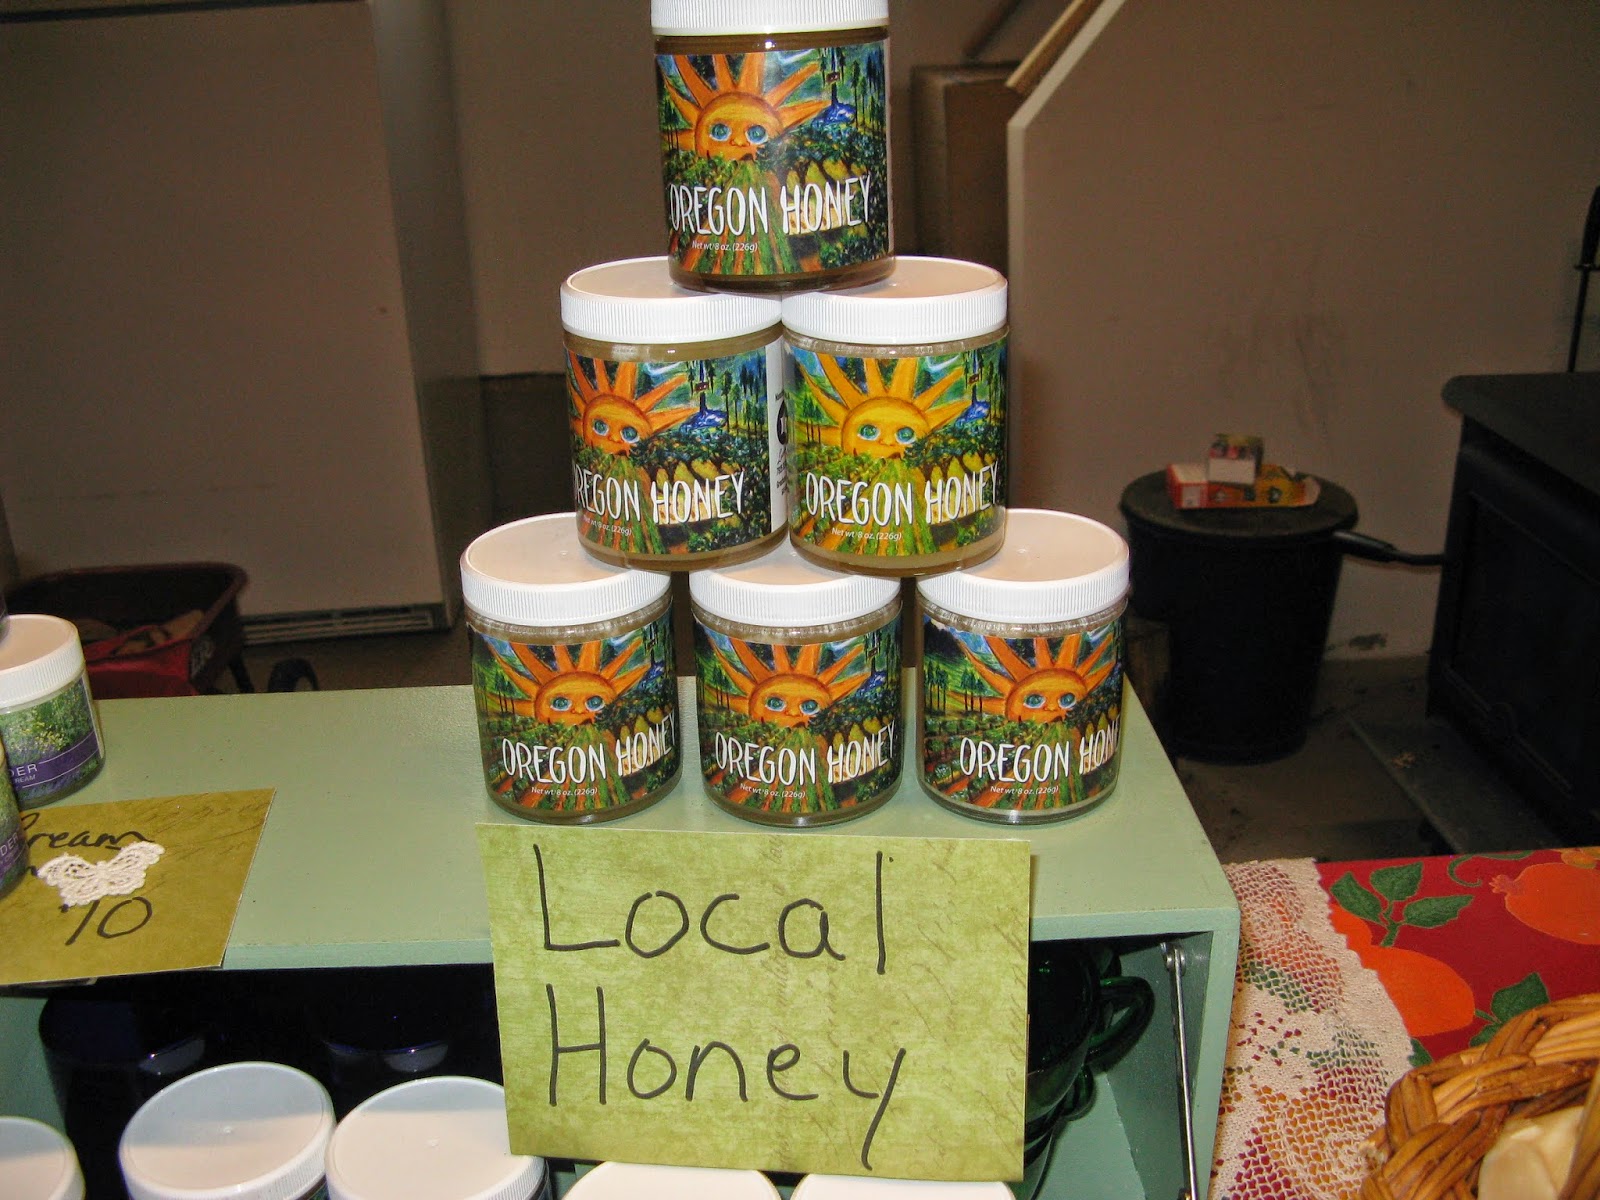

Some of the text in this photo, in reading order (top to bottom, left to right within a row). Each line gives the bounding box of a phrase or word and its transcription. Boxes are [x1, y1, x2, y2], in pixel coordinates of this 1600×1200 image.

[669, 174, 872, 236] OREGON HONEY
[691, 240, 758, 253] Net wt 8 oz. (226g)
[651, 471, 745, 524] HONEY
[806, 461, 998, 526] OREGON HONEY
[831, 527, 844, 537] Net
[857, 531, 863, 539] 8
[863, 532, 875, 540] oz.
[875, 532, 902, 542] (226g)
[502, 708, 676, 784] OREGON HONEY
[715, 720, 895, 786] OREGON HONEY
[960, 737, 1069, 783] OREGON
[531, 786, 544, 794] Net
[556, 788, 561, 796] 8
[574, 786, 598, 796] (226g)
[740, 782, 752, 792] Net
[764, 788, 769, 796] 8
[781, 790, 806, 799] (226g)
[990, 785, 1004, 793] Net
[1017, 787, 1023, 795] 8
[1023, 788, 1035, 796] oz.
[1035, 785, 1059, 795] (226g)
[532, 843, 886, 975] Local
[545, 983, 907, 1171] Honey
